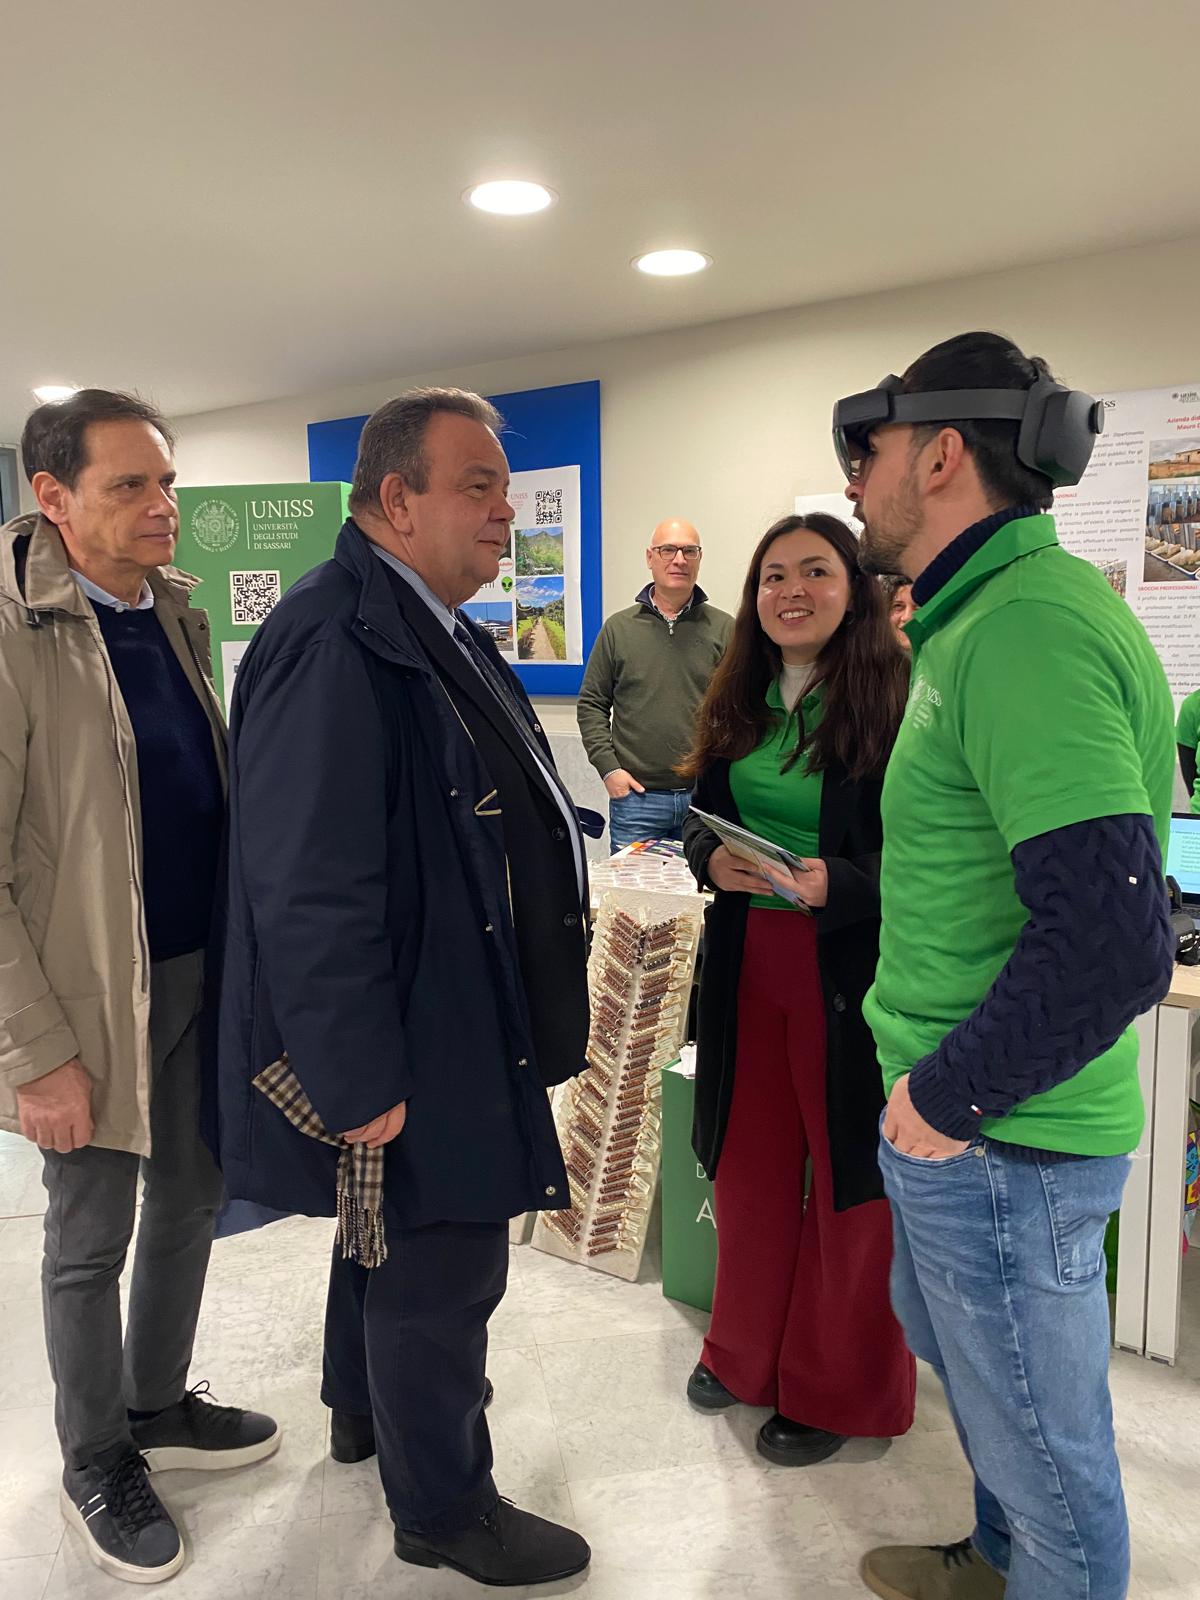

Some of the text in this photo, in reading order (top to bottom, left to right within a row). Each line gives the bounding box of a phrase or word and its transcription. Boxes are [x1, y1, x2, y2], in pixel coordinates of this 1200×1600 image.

[251, 499, 314, 518] UNISS
[253, 521, 298, 531] UNIVERSITÀ
[253, 532, 298, 541] DEGLI STUDI
[254, 542, 262, 550] DI
